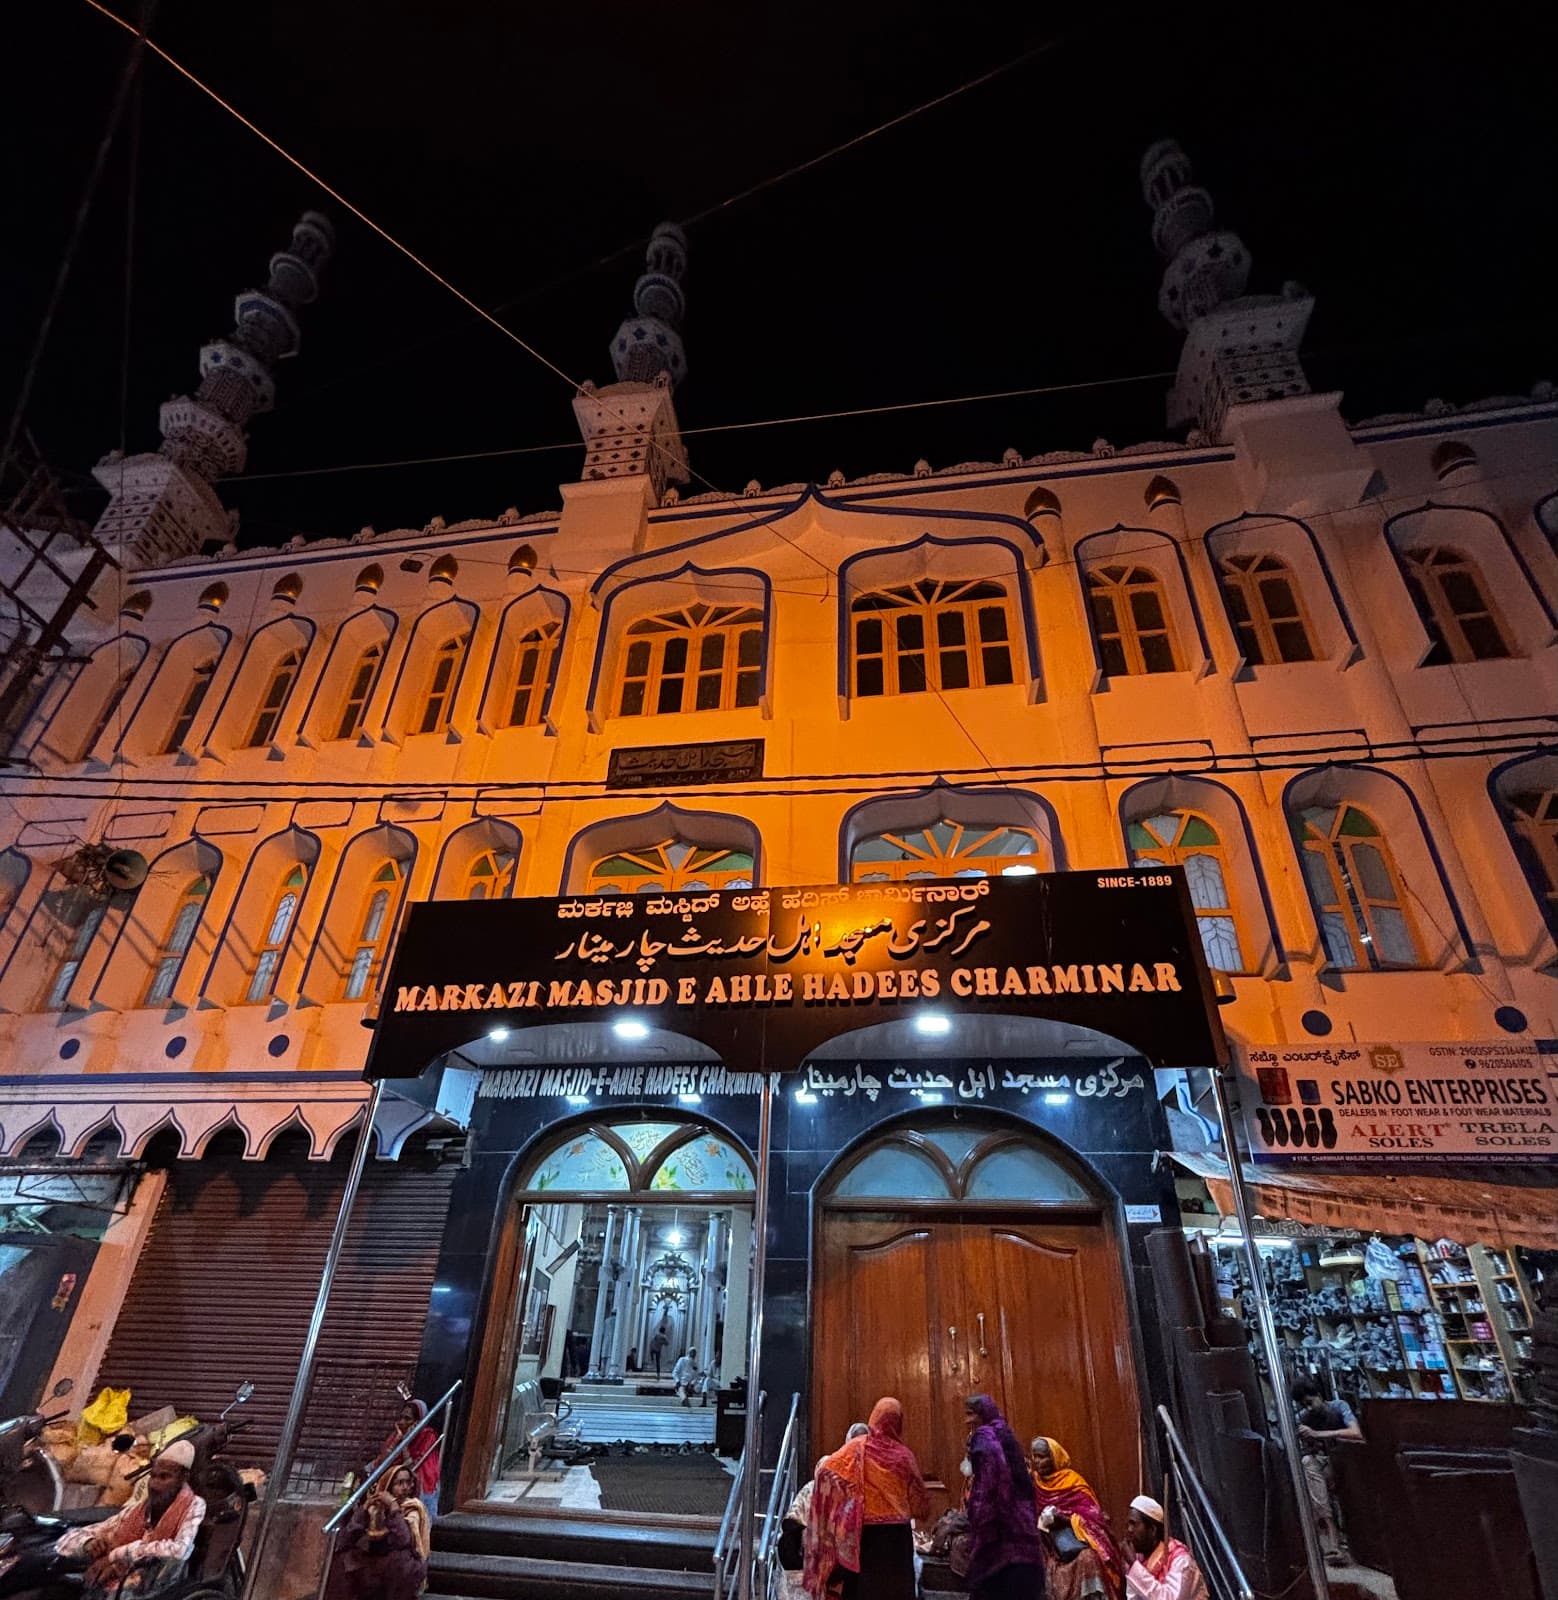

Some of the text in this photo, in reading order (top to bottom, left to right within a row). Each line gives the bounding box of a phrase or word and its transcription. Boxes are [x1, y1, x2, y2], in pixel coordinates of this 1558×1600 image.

[1097, 875, 1173, 889] SINCE-1889
[394, 962, 1183, 1012] MARKAZI MASJID E AHLE HADEES CHARMINAR
[478, 1069, 541, 1098] MARKAZI
[644, 1066, 699, 1095] HADEES
[1002, 1069, 1071, 1095] مسجد
[1075, 1057, 1144, 1097] مرکزی
[1331, 1078, 1548, 1105] SABKO ENTERPRISES
[1339, 1108, 1377, 1117] DEALERS
[1391, 1108, 1413, 1117] FOOT
[1415, 1108, 1441, 1117] WEAR
[1442, 1108, 1449, 1117] &
[1450, 1108, 1473, 1117] FOOT
[1476, 1107, 1501, 1117] WEAR
[1502, 1107, 1552, 1117] MATERIALS
[1460, 1121, 1558, 1134] TRELA
[1368, 1137, 1435, 1148] SOLES
[1475, 1136, 1552, 1146] SOLES
